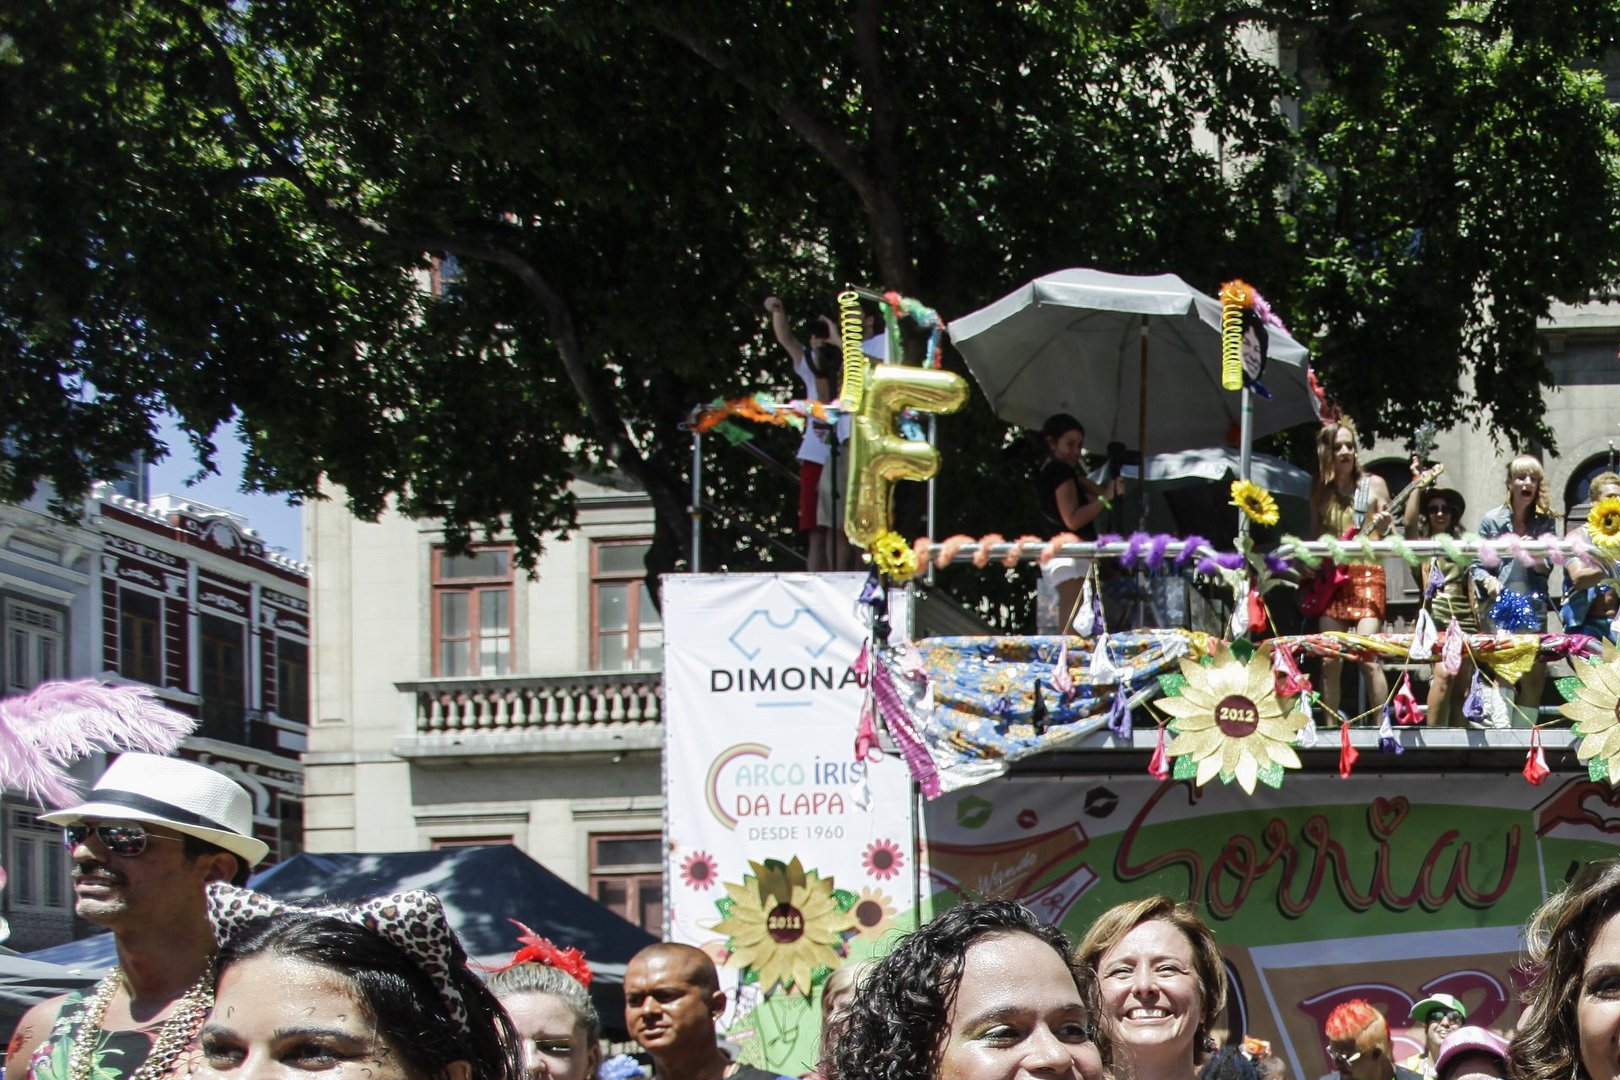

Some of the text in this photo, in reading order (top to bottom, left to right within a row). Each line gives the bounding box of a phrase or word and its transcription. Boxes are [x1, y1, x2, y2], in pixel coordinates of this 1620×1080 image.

[844, 363, 968, 548] F
[1219, 707, 1255, 723] 2012
[735, 762, 805, 787] ARCO
[736, 792, 845, 818] DA LAPA
[748, 824, 845, 842] DESDE 1960
